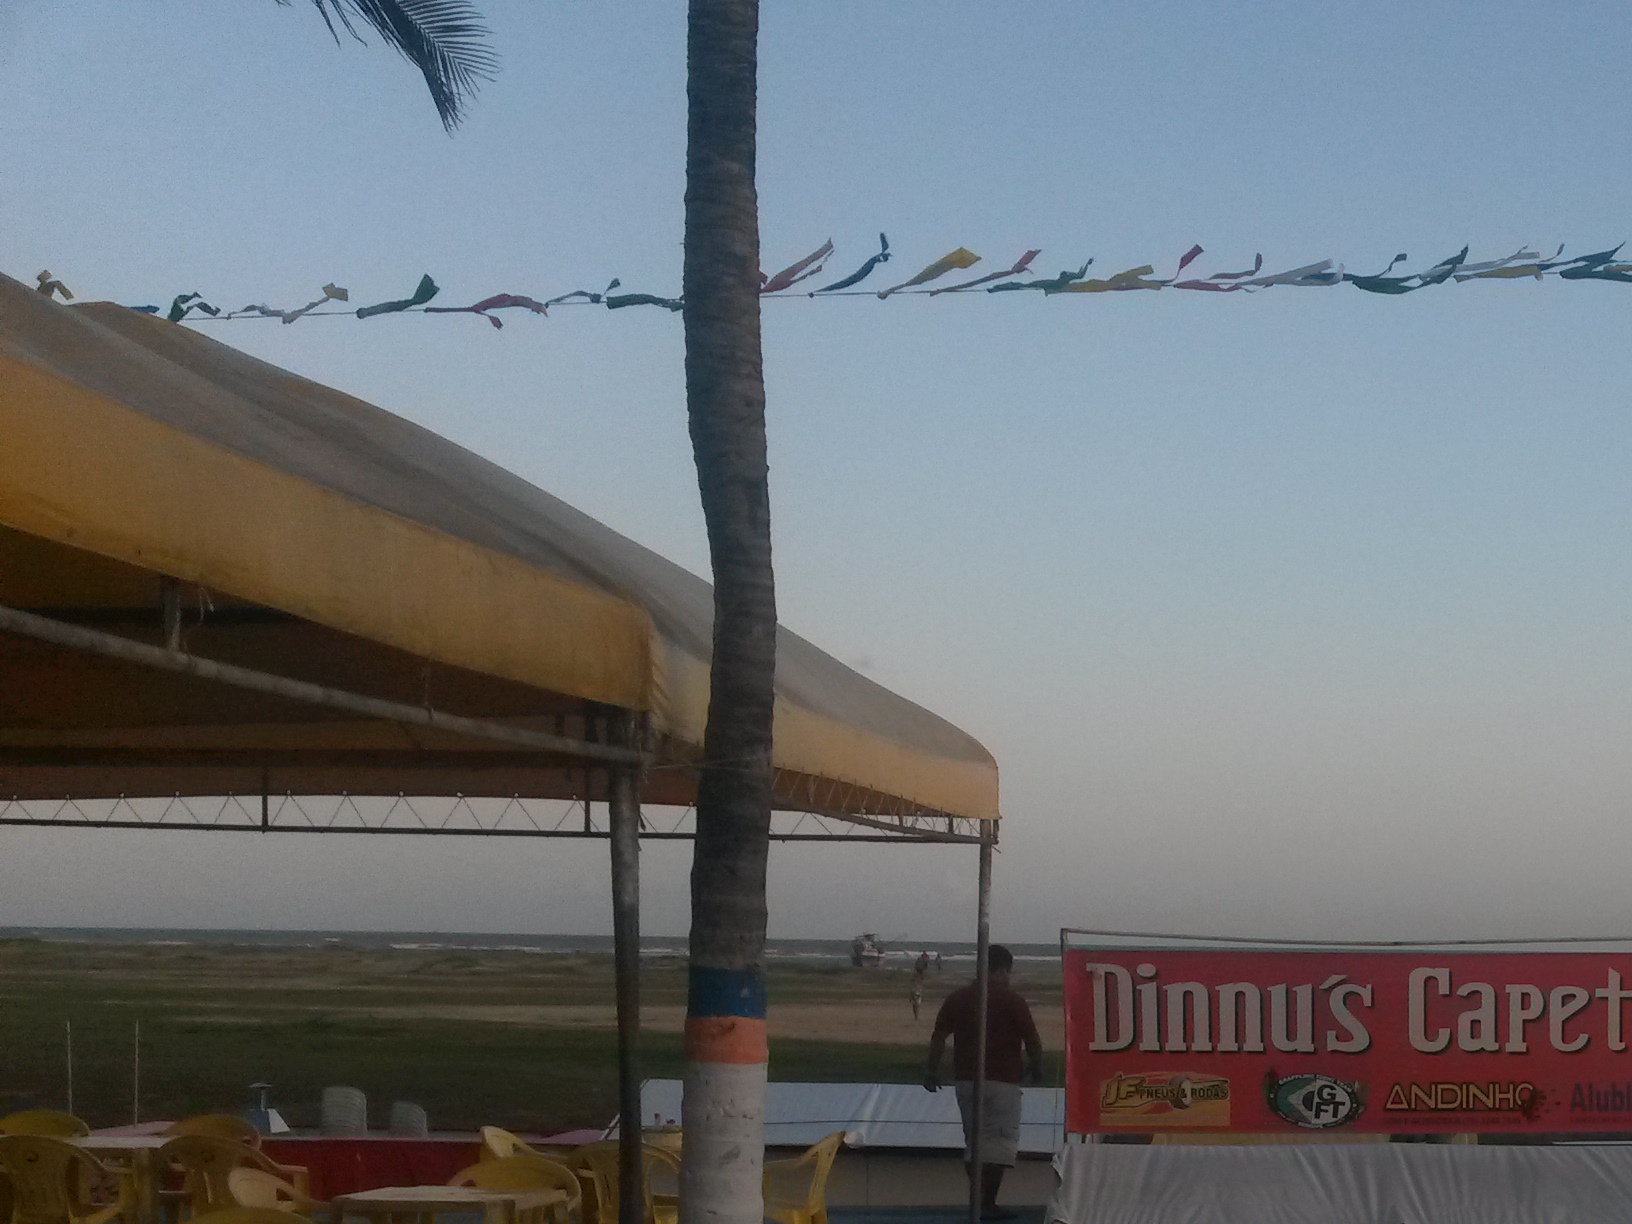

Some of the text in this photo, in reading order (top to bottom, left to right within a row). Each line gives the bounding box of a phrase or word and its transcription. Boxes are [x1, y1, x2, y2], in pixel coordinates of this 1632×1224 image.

[1190, 1087, 1228, 1100] RODAS
[1316, 1084, 1338, 1102] G
[1384, 1081, 1535, 1111] ANDINHO
[1314, 1101, 1346, 1119] FT
